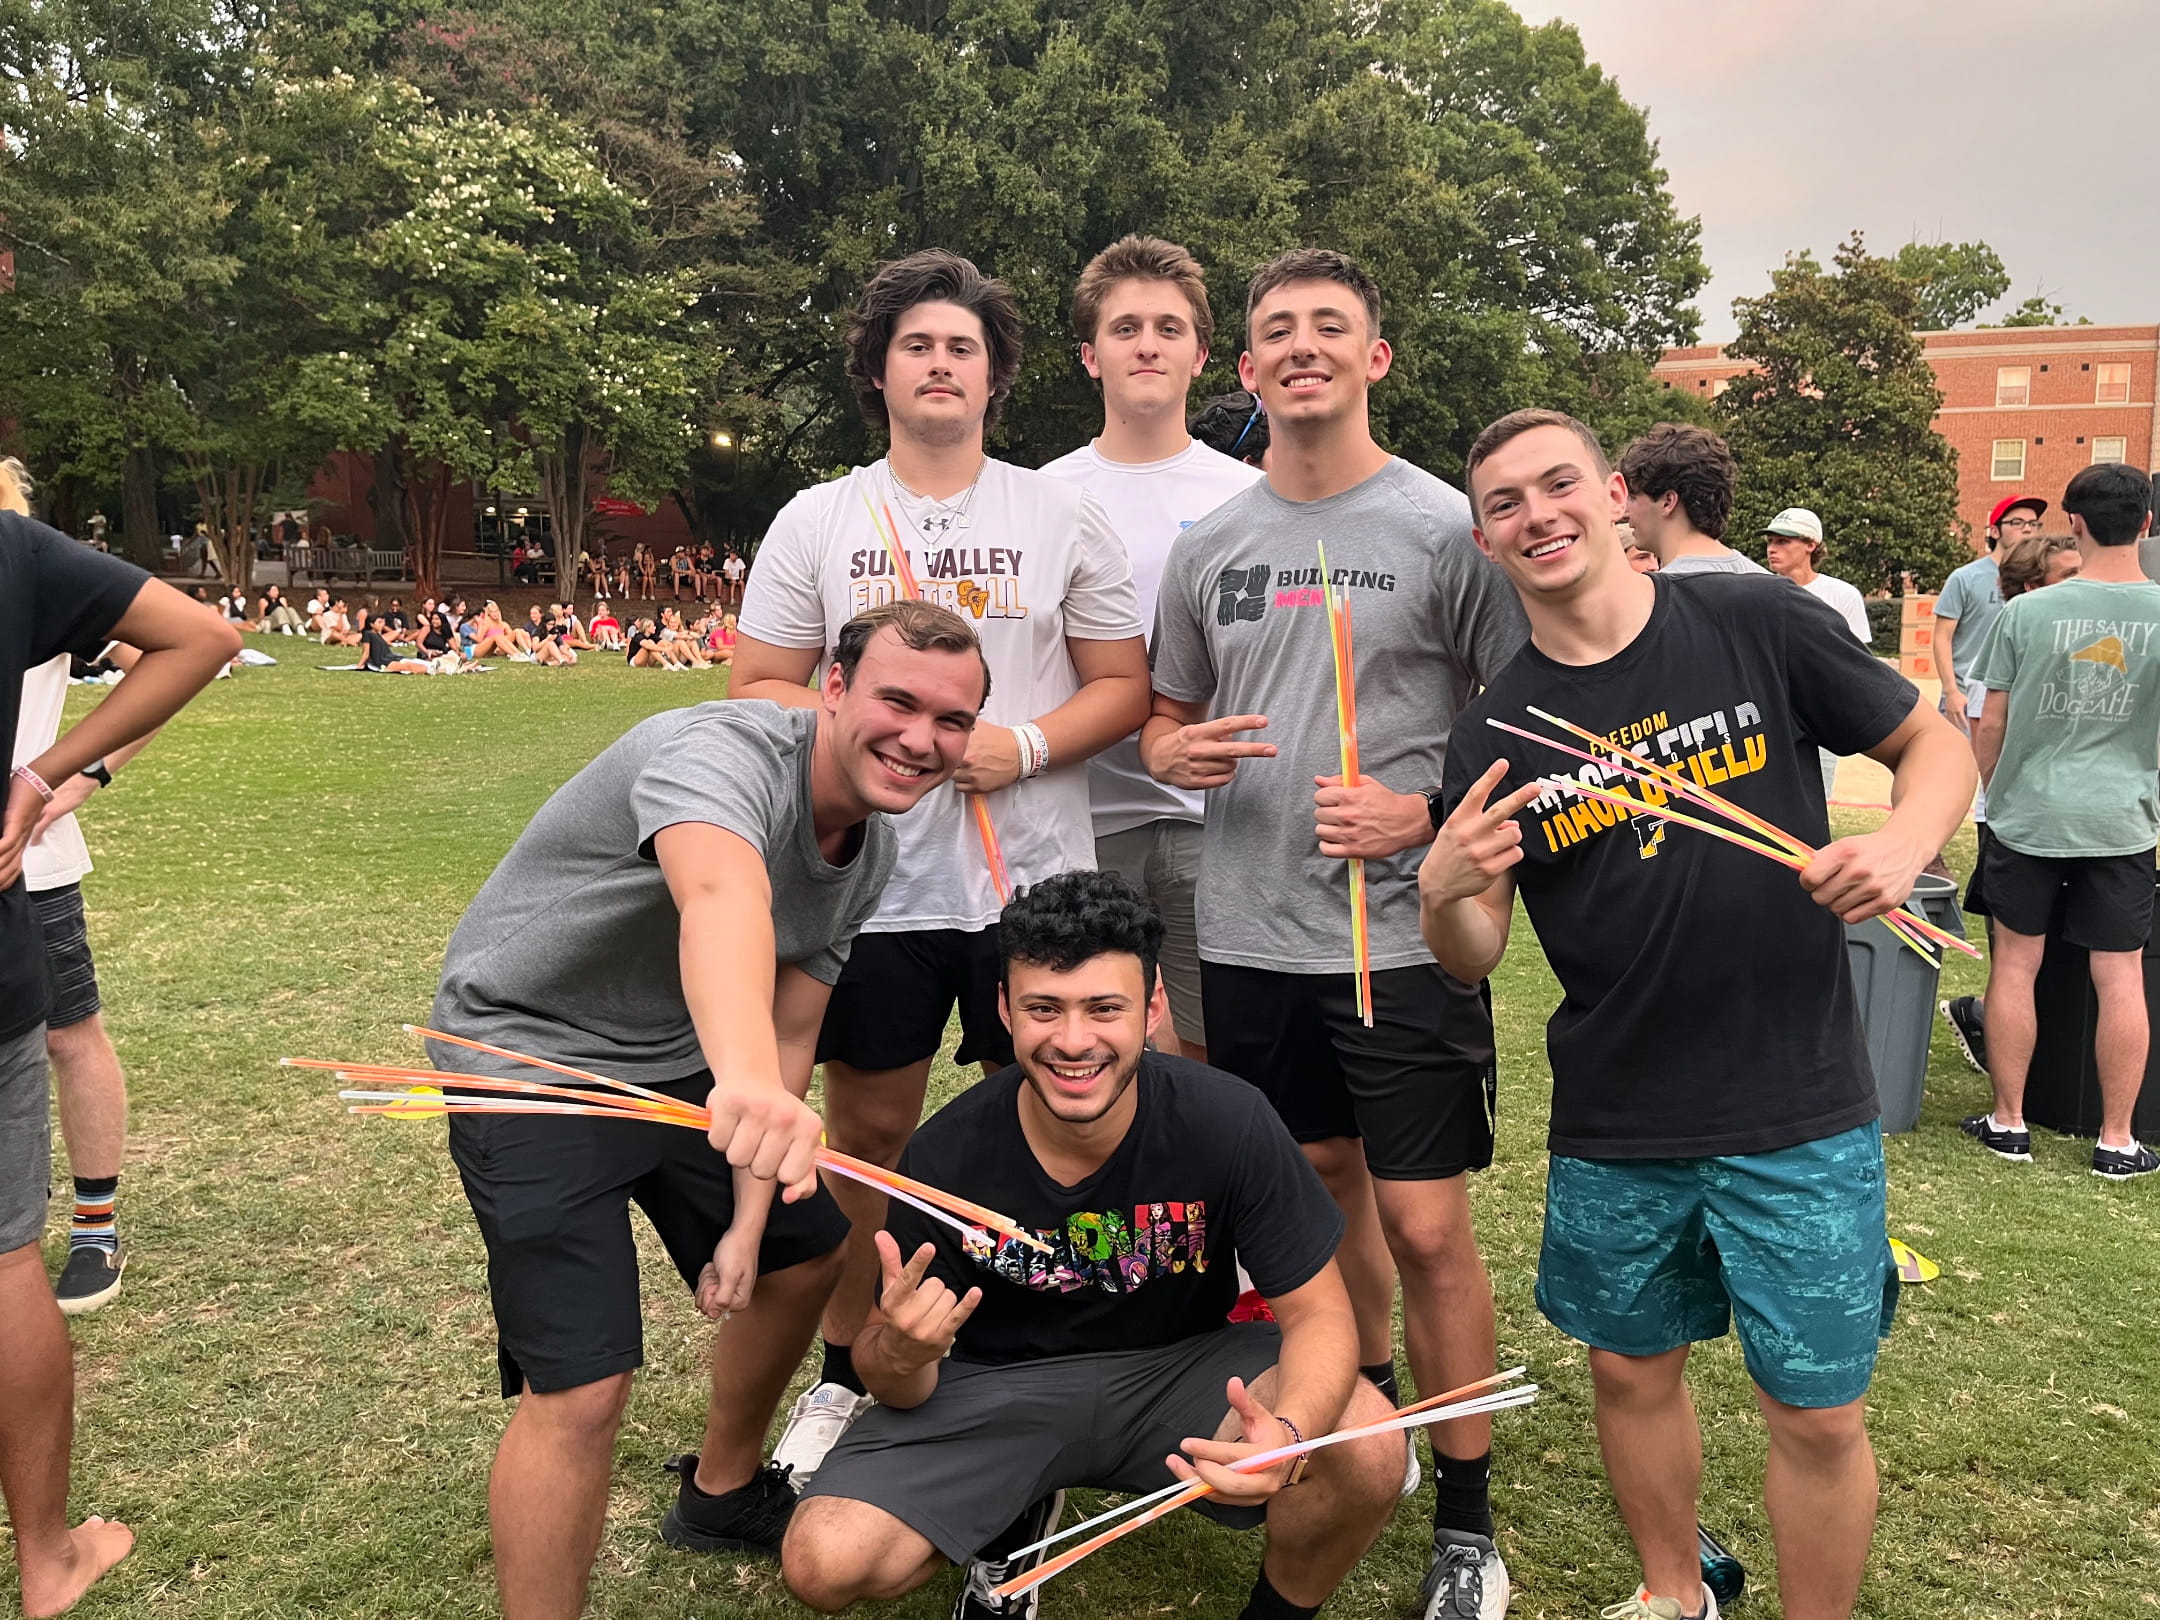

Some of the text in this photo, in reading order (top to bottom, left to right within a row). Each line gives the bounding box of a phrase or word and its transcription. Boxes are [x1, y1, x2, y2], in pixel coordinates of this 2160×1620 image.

[924, 547, 1024, 579] VALLEY
[1277, 568, 1396, 592] BUILDING
[849, 577, 1029, 620] FOTBLL
[1275, 588, 1325, 608] MEN
[2051, 619, 2160, 657] THE SALTY
[2037, 682, 2140, 716] DOG CAFE
[1590, 710, 1669, 757] FREEDOM
